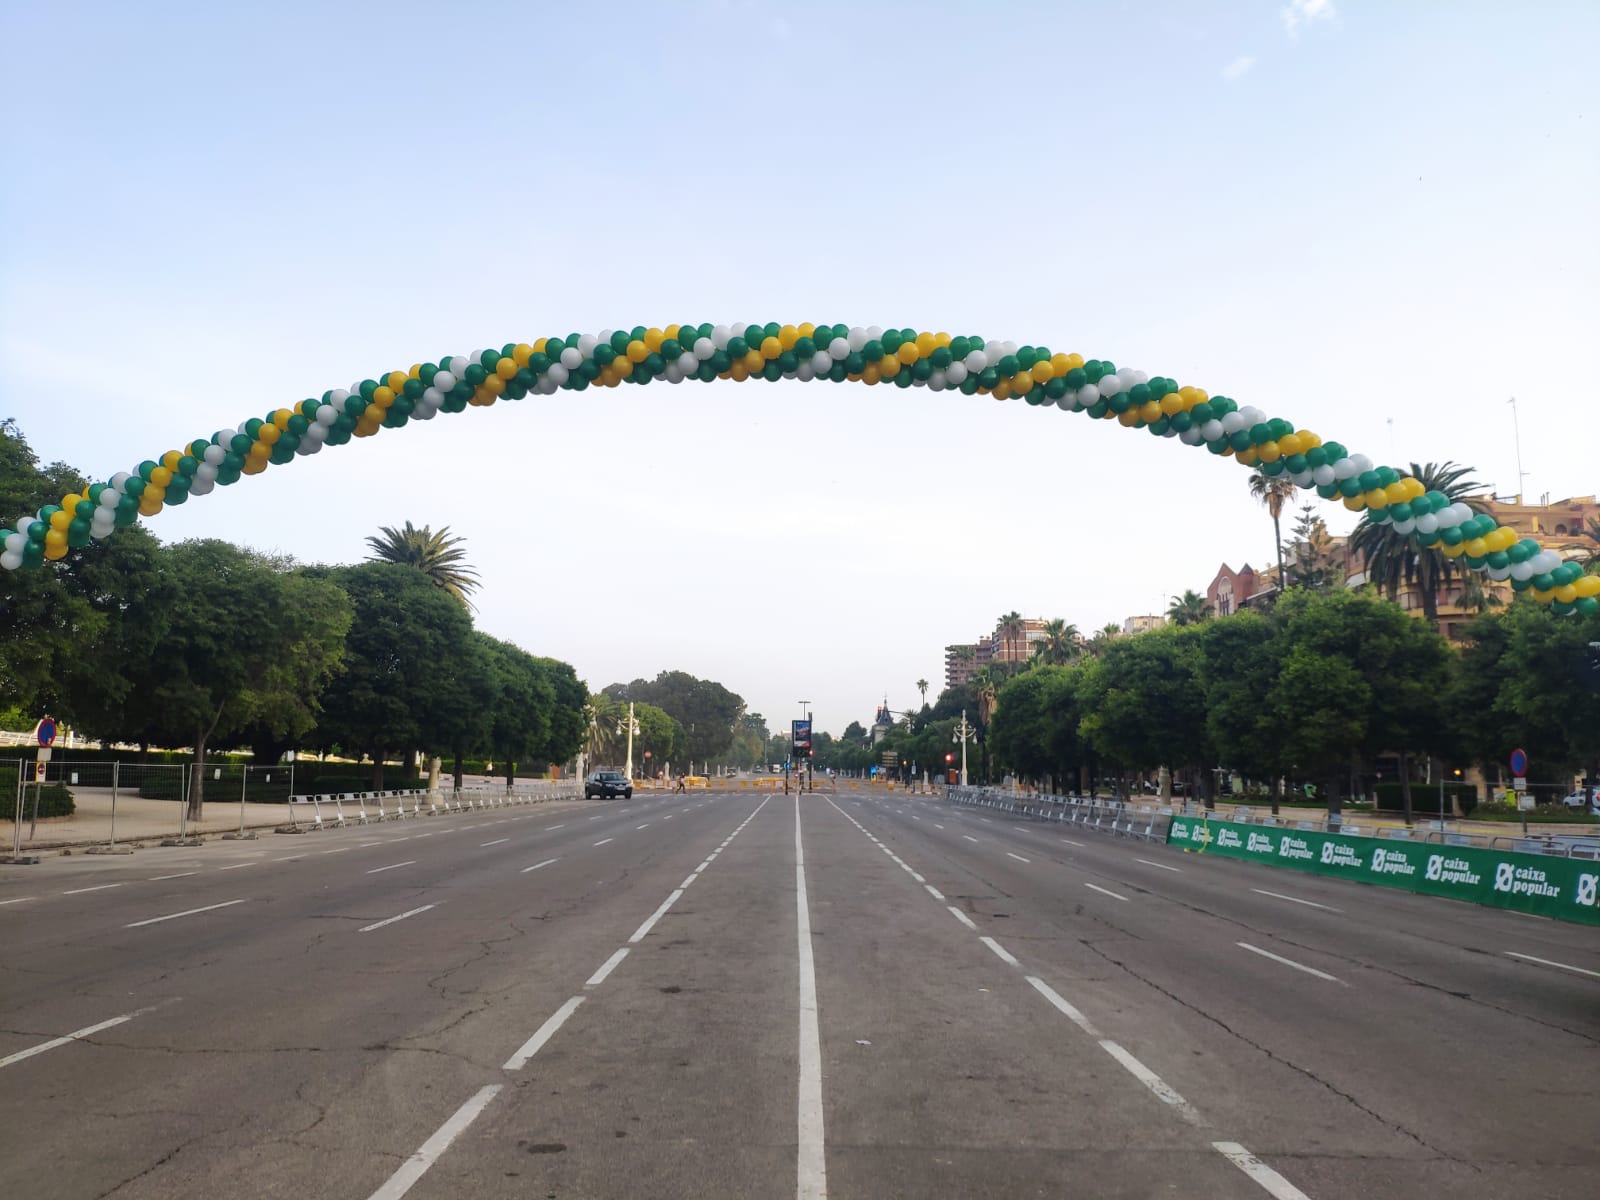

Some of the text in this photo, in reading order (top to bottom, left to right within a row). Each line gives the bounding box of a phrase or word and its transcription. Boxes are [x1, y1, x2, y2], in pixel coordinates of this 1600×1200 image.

[1335, 844, 1354, 855] caixa
[1332, 855, 1362, 866] popular
[1387, 851, 1406, 862] caixa
[1384, 862, 1416, 874] popular
[1444, 858, 1470, 870] caixa
[1441, 870, 1480, 884] popular
[1516, 866, 1546, 881] caixa
[1513, 880, 1560, 897] popular
